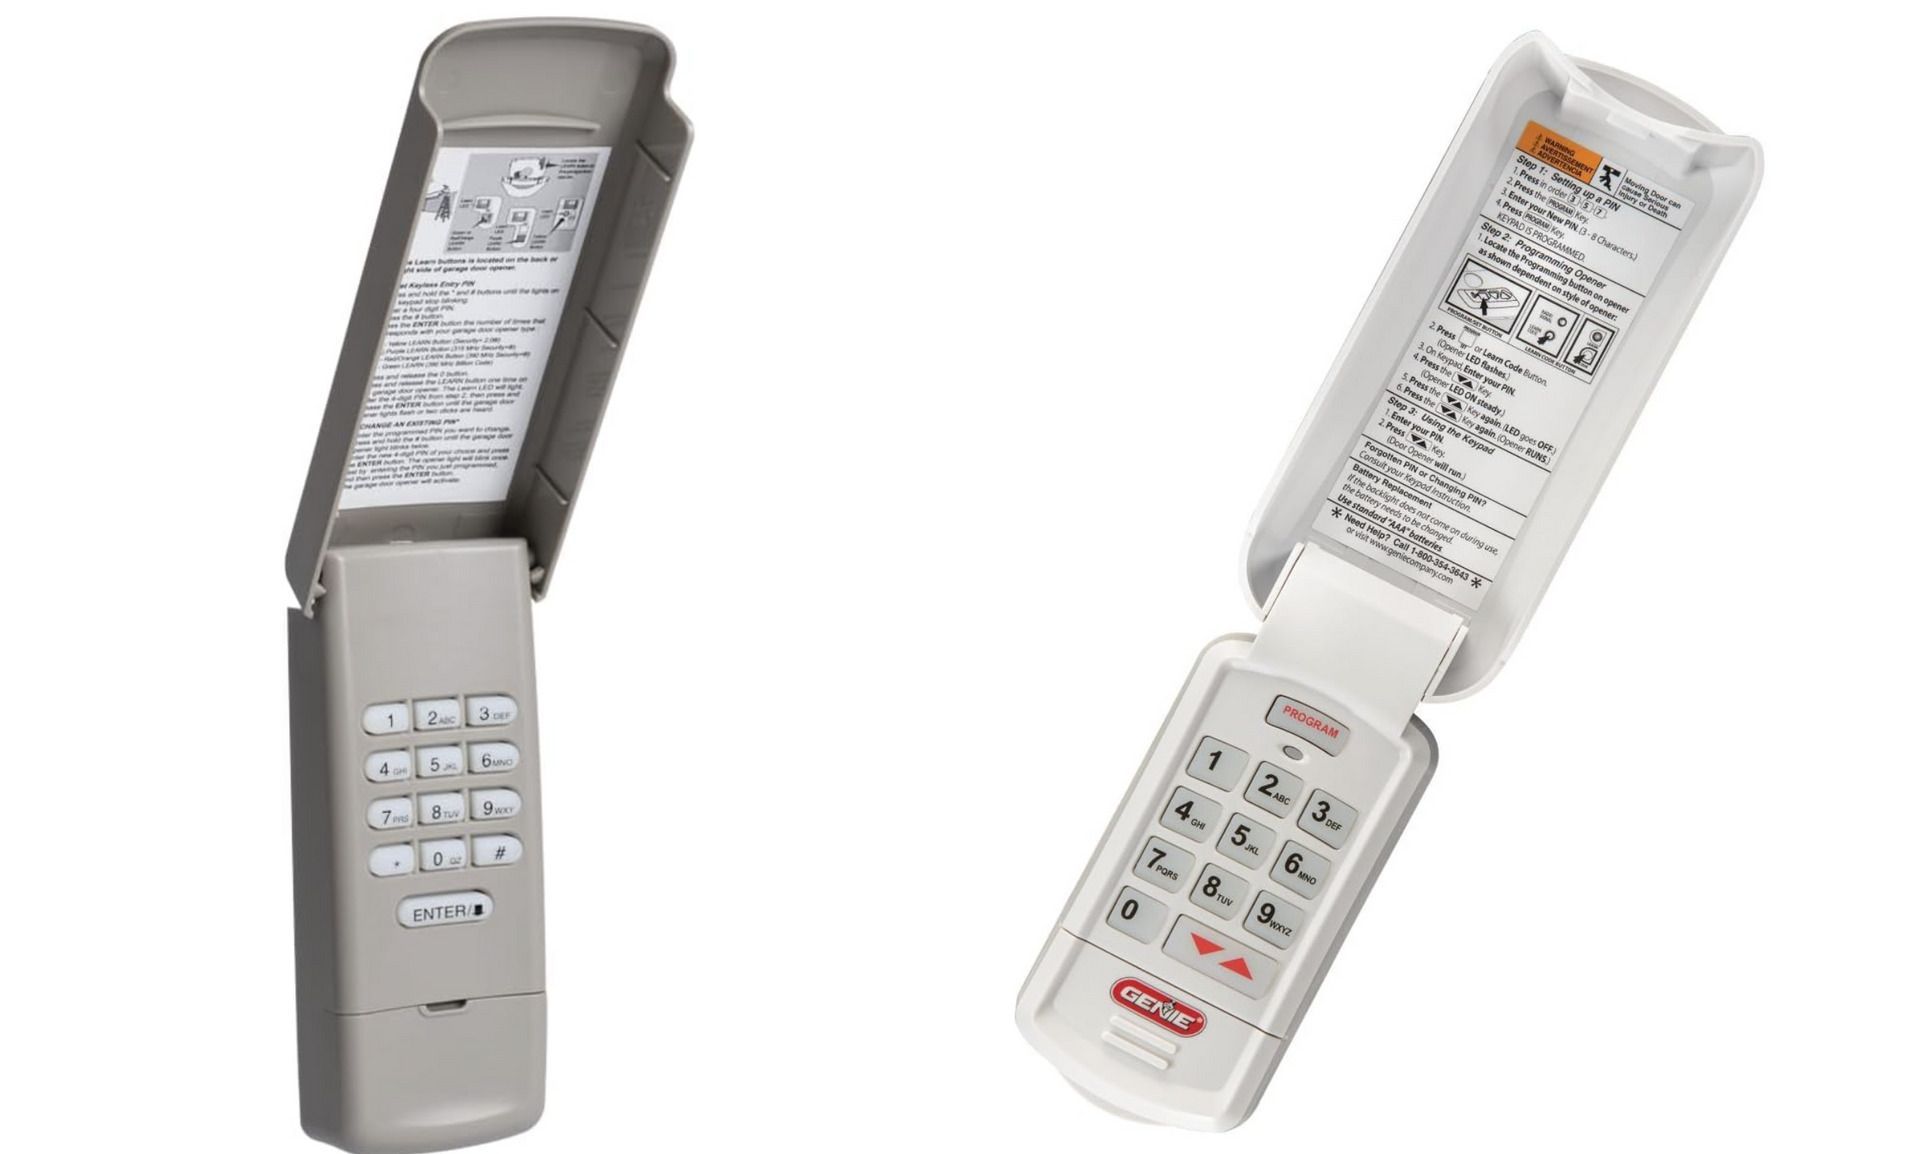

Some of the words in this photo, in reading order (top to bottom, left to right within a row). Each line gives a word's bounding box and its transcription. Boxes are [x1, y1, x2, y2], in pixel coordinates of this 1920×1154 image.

[1540, 143, 1593, 173] AVERTISSEMENT
[1544, 137, 1575, 156] WARNING
[1537, 150, 1582, 177] ADVERTENCIA
[1513, 166, 1520, 176] 1.
[1519, 169, 1539, 185] Press
[1539, 179, 1547, 189] in
[1547, 185, 1567, 199] order
[1516, 154, 1537, 170] Step
[1538, 166, 1548, 176] 1:
[1550, 172, 1582, 194] Setting
[1582, 189, 1595, 199] up
[1602, 198, 1621, 211] PIN
[1624, 176, 1649, 195] Moving
[1650, 189, 1667, 202] Door
[1668, 199, 1681, 209] can
[1500, 188, 1509, 197] 3.
[1507, 191, 1529, 206] Enter
[1527, 202, 1546, 215] your
[1546, 210, 1564, 224] New
[1617, 189, 1638, 204] Injury
[1647, 204, 1667, 218] Death
[1621, 184, 1642, 197] cause
[1642, 193, 1669, 211] Serious
[1496, 211, 1525, 231] KEYPAD
[1524, 226, 1533, 235] IS
[438, 257, 466, 265] buttons
[477, 256, 504, 264] located
[1480, 221, 1501, 237] Step
[1501, 232, 1512, 243] 2:
[1514, 239, 1573, 274] Programming
[1574, 269, 1607, 289] Opener
[1477, 232, 1484, 242] 1.
[1483, 236, 1507, 253] Locate
[1507, 248, 1520, 260] the
[1519, 254, 1568, 285] Programming
[1567, 278, 1593, 296] button
[1592, 292, 1603, 301] on
[1603, 297, 1630, 313] opener
[1478, 247, 1487, 256] as
[1487, 252, 1511, 268] shown
[1511, 264, 1551, 288] dependent
[1551, 285, 1562, 294] on
[1561, 290, 1580, 303] style
[1579, 299, 1590, 307] of
[1588, 303, 1618, 322] opener:
[1428, 321, 1437, 331] 2.
[1436, 324, 1456, 340] Press
[1473, 345, 1483, 353] or
[1482, 348, 1503, 364] Learn
[1503, 359, 1522, 374] Code
[1387, 396, 1407, 411] Step
[1407, 407, 1418, 417] 3:
[1420, 413, 1446, 432] Using
[1446, 426, 1461, 438] the
[1461, 433, 1495, 454] Keypad
[1352, 463, 1381, 483] Battery
[1381, 478, 1432, 509] Replacement
[1364, 440, 1402, 465] Forgotten
[1402, 460, 1418, 473] PIN
[1418, 470, 1428, 478] or
[1428, 474, 1466, 499] Changing
[1466, 493, 1487, 506] PIN?
[1384, 465, 1404, 477] your
[1403, 473, 1433, 492] Keypad
[1337, 493, 1352, 506] Use
[1351, 502, 1388, 523] standard
[1344, 513, 1366, 529] Need
[1366, 524, 1391, 541] Help?
[1393, 537, 1410, 551] Call
[1411, 547, 1469, 581] 1-800-354-3643
[1346, 526, 1355, 534] or
[1354, 530, 1369, 542] visit
[388, 714, 393, 727] 1
[428, 711, 437, 725] 2
[479, 707, 490, 720] 3
[493, 712, 511, 720] DEF
[1282, 705, 1339, 739] PROGRAM
[380, 763, 389, 776] 4
[431, 757, 440, 771] 5
[482, 754, 491, 767] 6
[492, 759, 513, 767] MNO
[1210, 751, 1222, 771] 1
[1258, 774, 1279, 796] 2
[1272, 792, 1291, 806] ABC
[382, 810, 391, 824] 7
[432, 805, 441, 819] 8
[484, 801, 493, 815] 9
[1175, 801, 1194, 821] 4
[1191, 818, 1205, 830] GHI
[1312, 801, 1331, 822] 3
[1325, 819, 1342, 832] DEF
[495, 846, 506, 860] #
[1231, 825, 1250, 846] 5
[1245, 843, 1260, 856] JKL
[433, 852, 442, 866] 0
[1148, 848, 1167, 868] 7
[1284, 853, 1303, 874] 6
[1298, 871, 1317, 885] MNO
[1156, 865, 1179, 881] PQRS
[1202, 876, 1221, 897] 8
[1216, 894, 1234, 906] TUV
[1121, 899, 1139, 920] 0
[1257, 903, 1275, 924] 9
[1269, 920, 1293, 937] WXYZ
[1120, 986, 1196, 1030] GENIE
